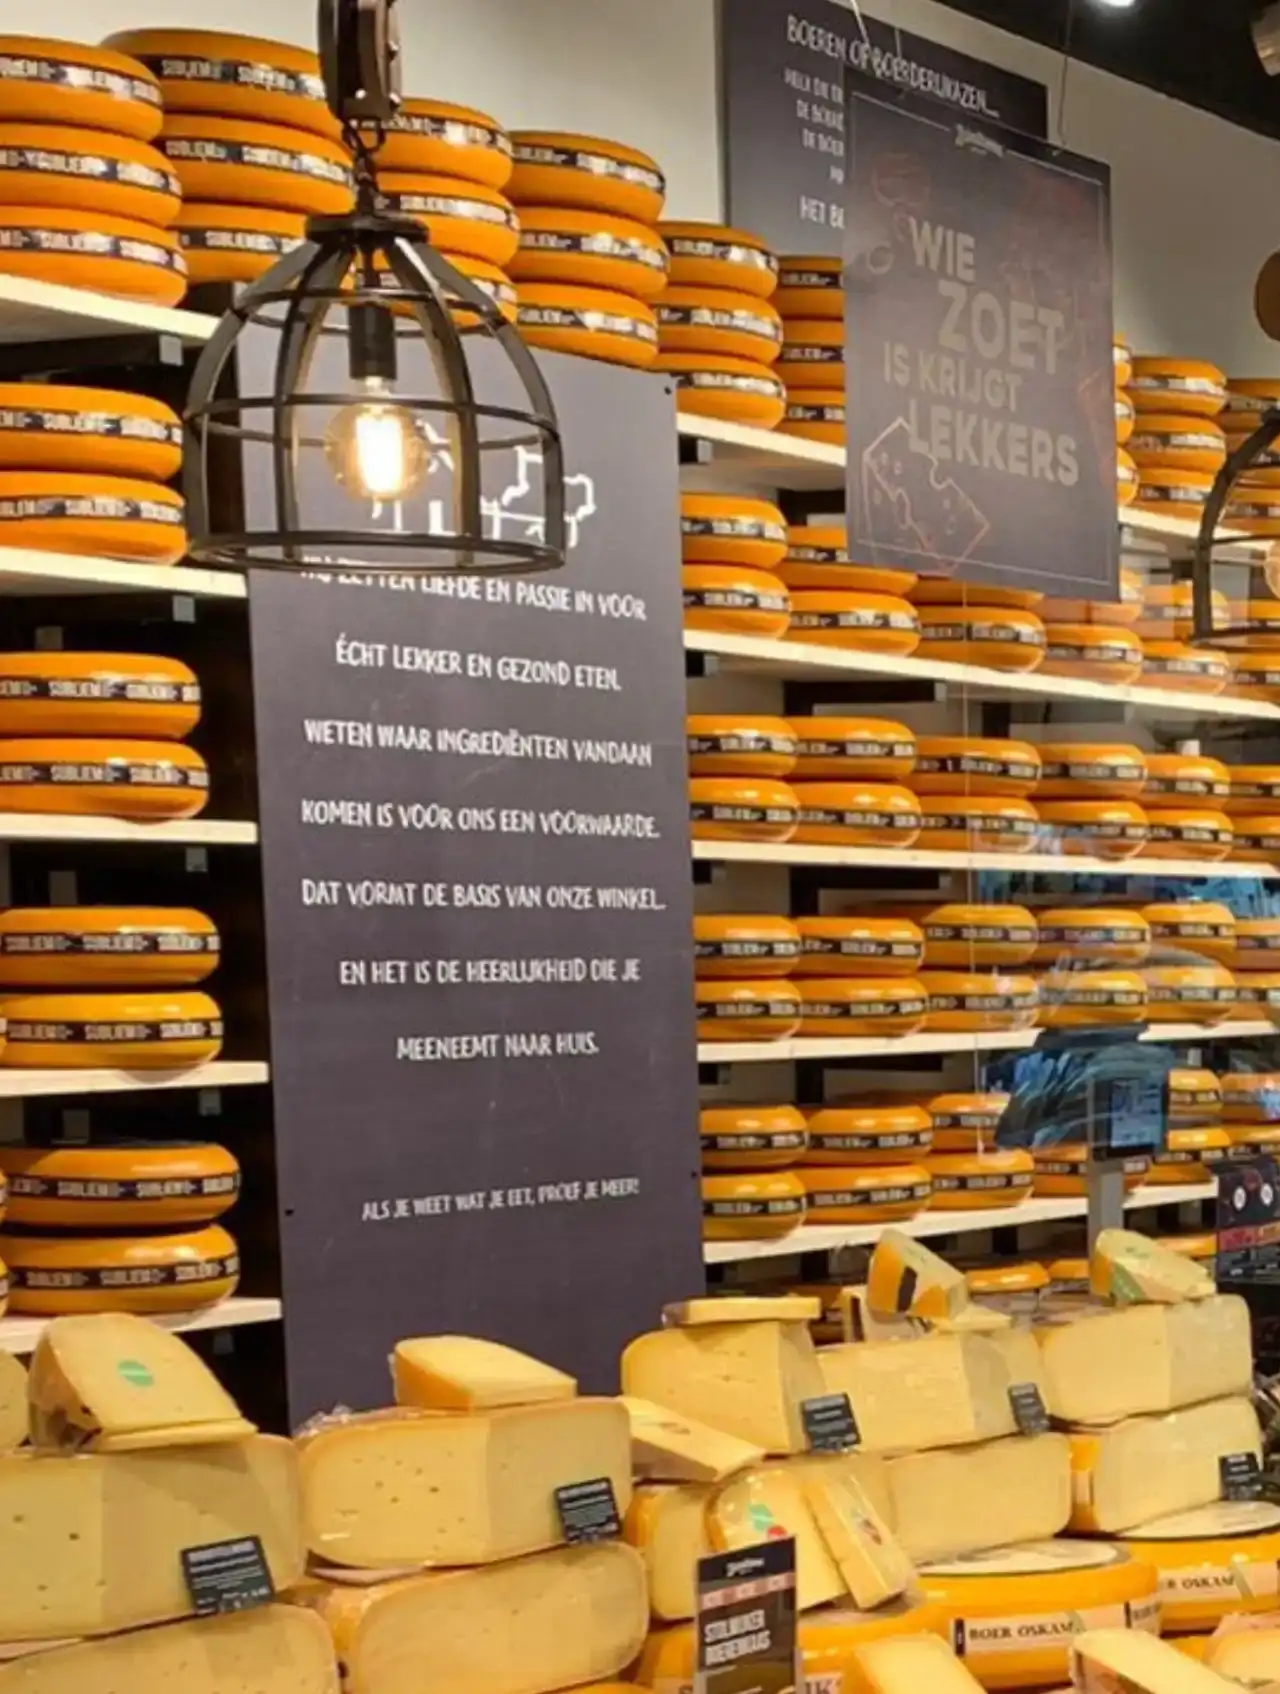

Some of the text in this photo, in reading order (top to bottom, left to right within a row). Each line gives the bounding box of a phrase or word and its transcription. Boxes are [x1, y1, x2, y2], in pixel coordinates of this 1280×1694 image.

[787, 14, 846, 60] BOEREN
[909, 218, 976, 281] WIE
[938, 281, 1066, 376] ZOET
[884, 341, 1020, 410] IS KRIJGT
[908, 400, 1080, 486] LEKKERS
[485, 578, 511, 604] EN
[516, 581, 572, 612] PASSIE
[574, 590, 594, 614] IN
[597, 593, 648, 621] VOOR
[335, 632, 622, 690] ÉCHT LEKKER EN GEZOND ETEN.
[305, 719, 653, 767] WETEN WAAR INGREDIËNTEN VANDAAN
[301, 800, 661, 839] KOMEN IS VOOR ONS EEN VOORWAARDE.
[302, 879, 667, 911] DAT VORMT DE BASIS VAN ONZE WINKEL.
[340, 957, 641, 985] EN HET IS DE HEERLIJKHEID DIE JE
[396, 1032, 600, 1061] MEENEEMT NAAR HUIS.
[361, 1199, 391, 1221] ALS
[393, 1198, 413, 1218] JE
[414, 1195, 451, 1216] WEET
[455, 1192, 484, 1213] WAT
[488, 1191, 505, 1209] JE
[583, 1181, 601, 1200] JE
[969, 1623, 1011, 1640] BOER
